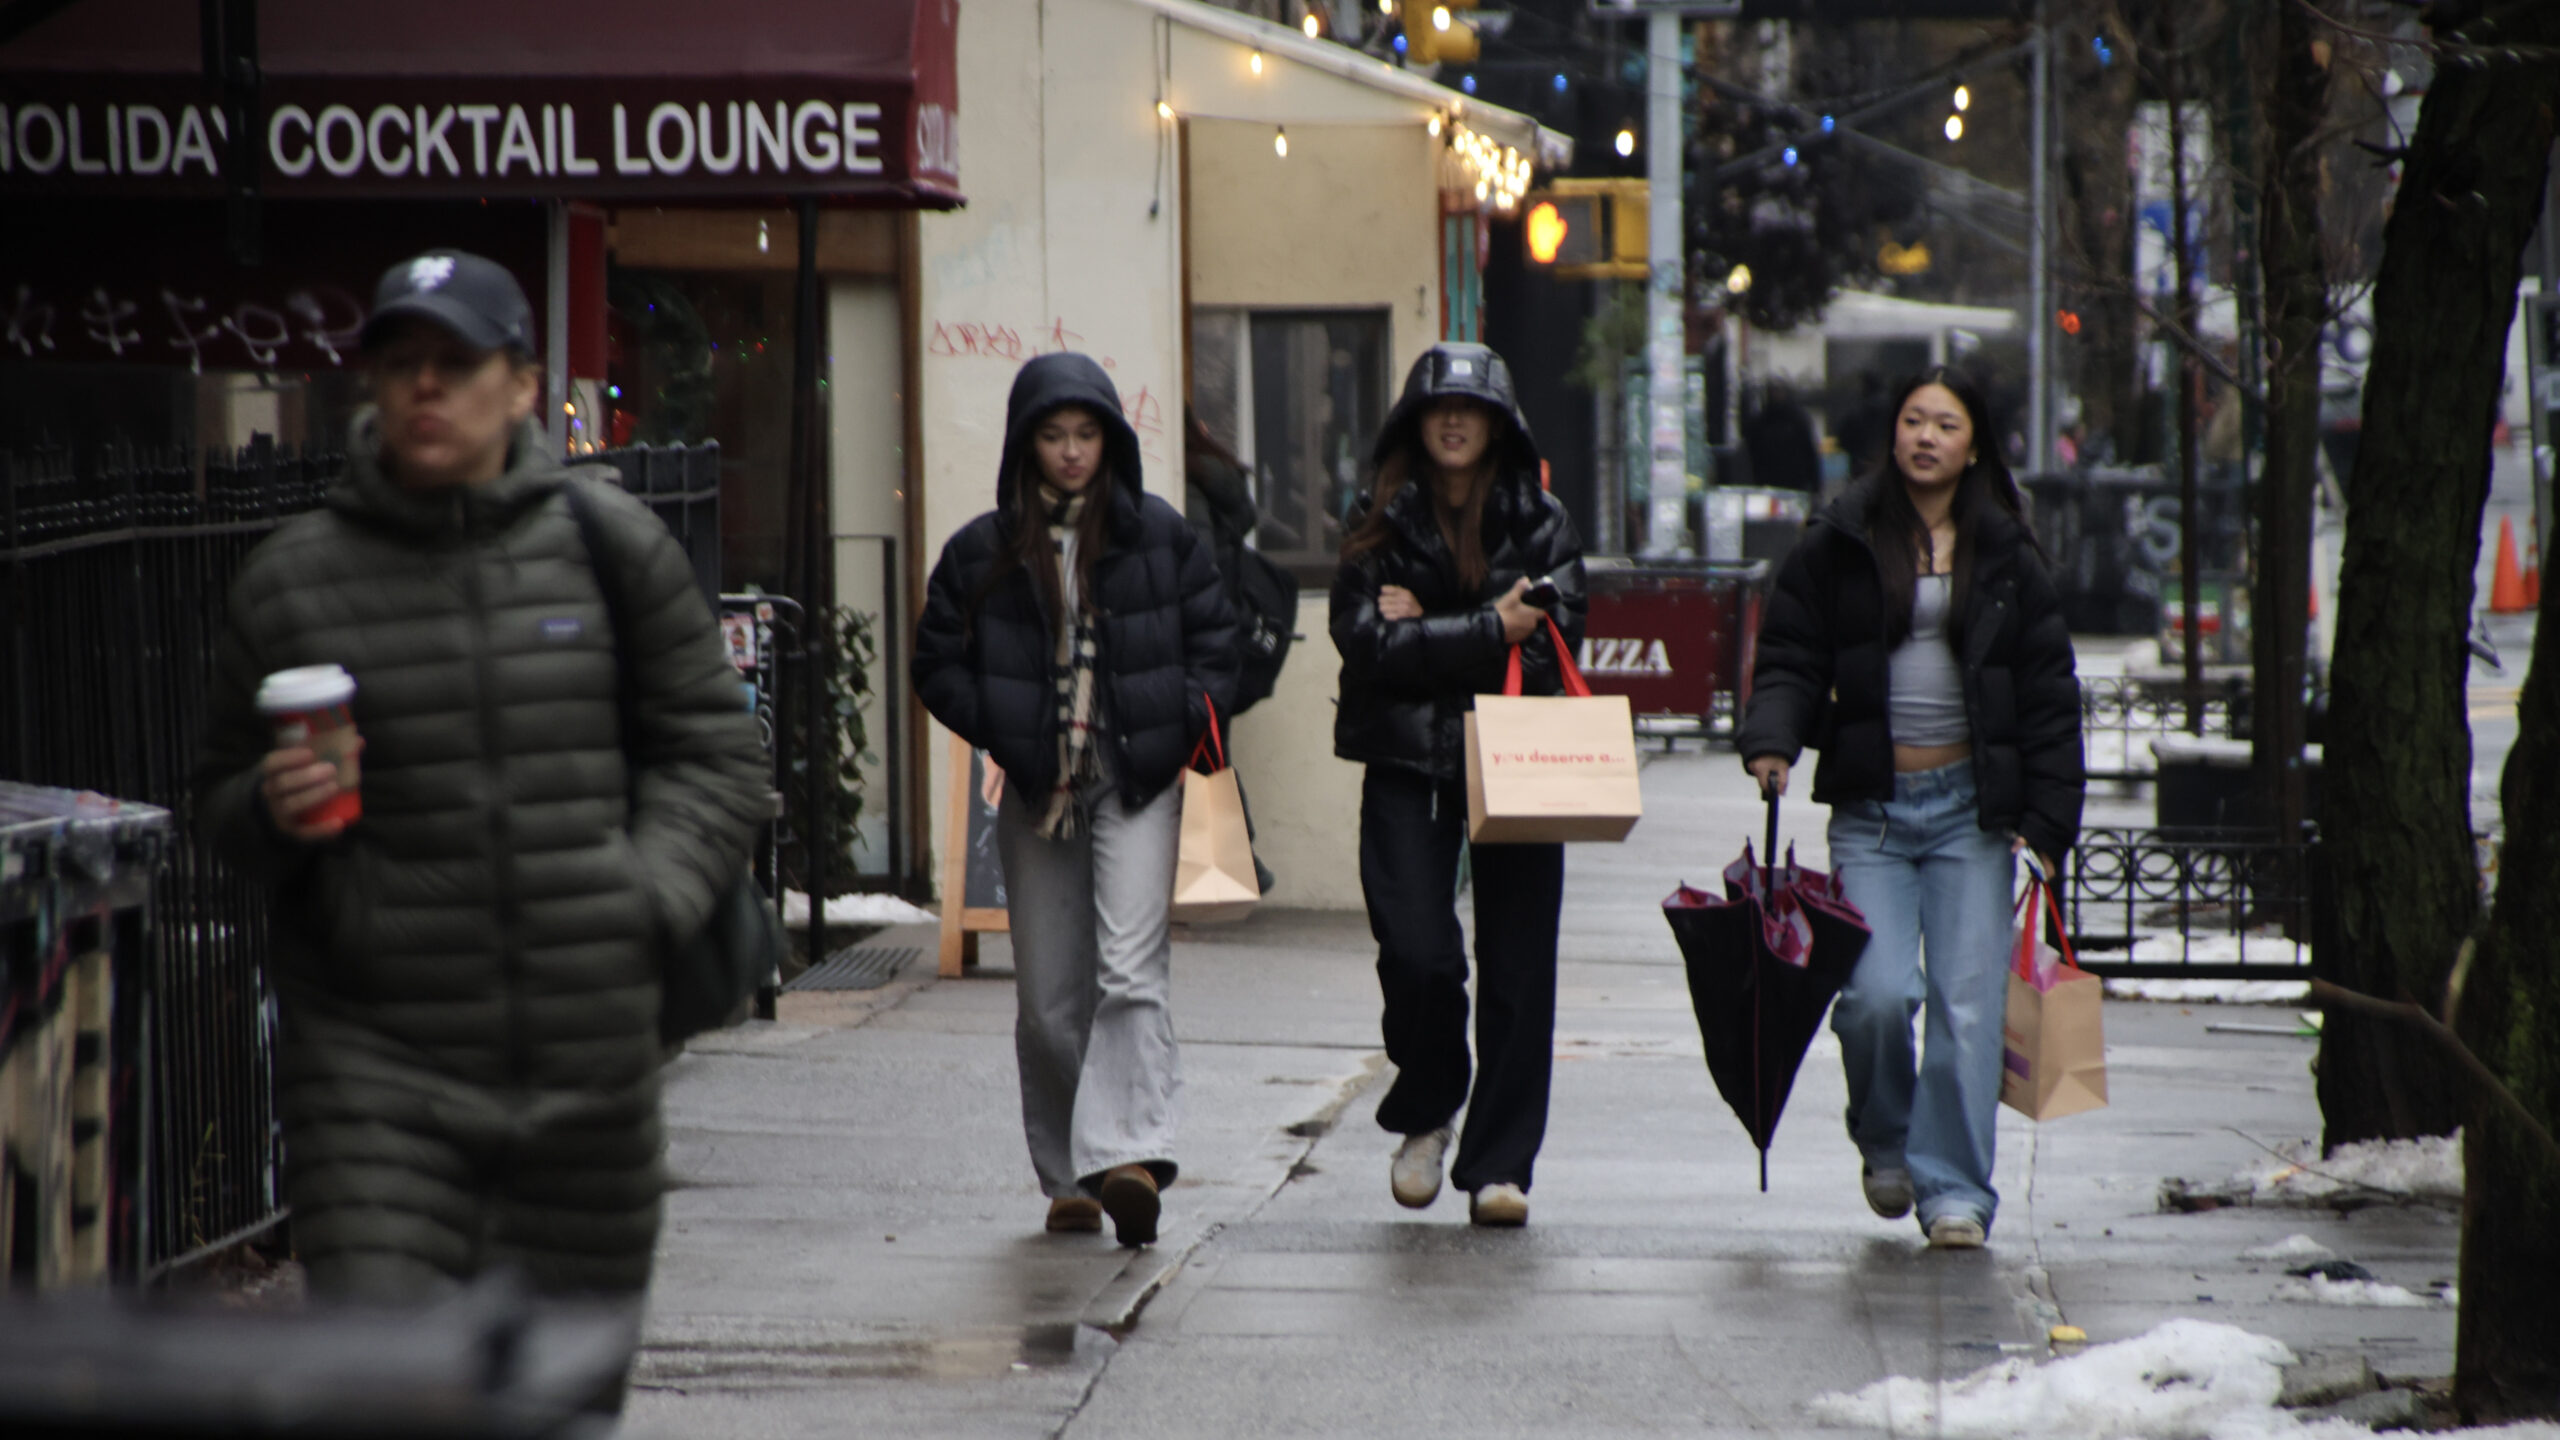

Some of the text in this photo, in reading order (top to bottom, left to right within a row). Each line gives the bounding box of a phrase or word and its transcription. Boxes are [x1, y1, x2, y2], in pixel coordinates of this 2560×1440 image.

[268, 103, 600, 177] COCKTAIL
[613, 99, 884, 175] LOUNGE
[1577, 636, 1674, 674] IZZA
[1492, 752, 1524, 766] yu
[1529, 749, 1594, 764] deserve
